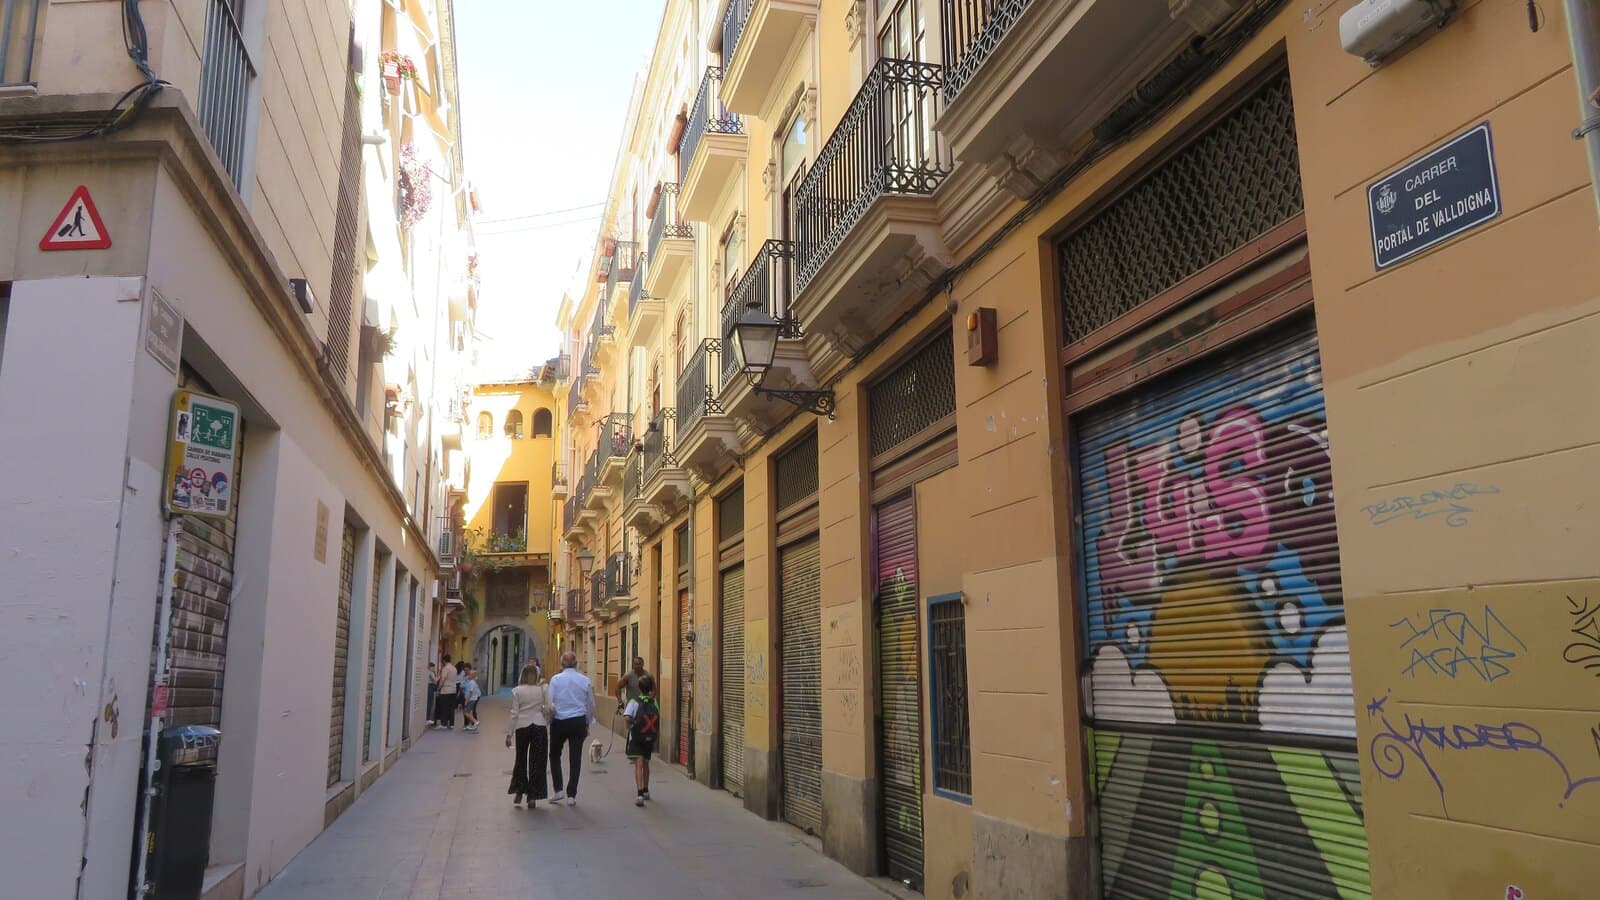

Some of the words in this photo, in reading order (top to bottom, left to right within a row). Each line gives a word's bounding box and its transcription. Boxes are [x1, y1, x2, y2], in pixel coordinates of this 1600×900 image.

[1404, 156, 1457, 192] CARRER
[1414, 189, 1441, 211] DEL
[1377, 229, 1414, 254] PORTAL
[1416, 214, 1430, 237] DE
[1432, 187, 1492, 227] VALLDIGNA
